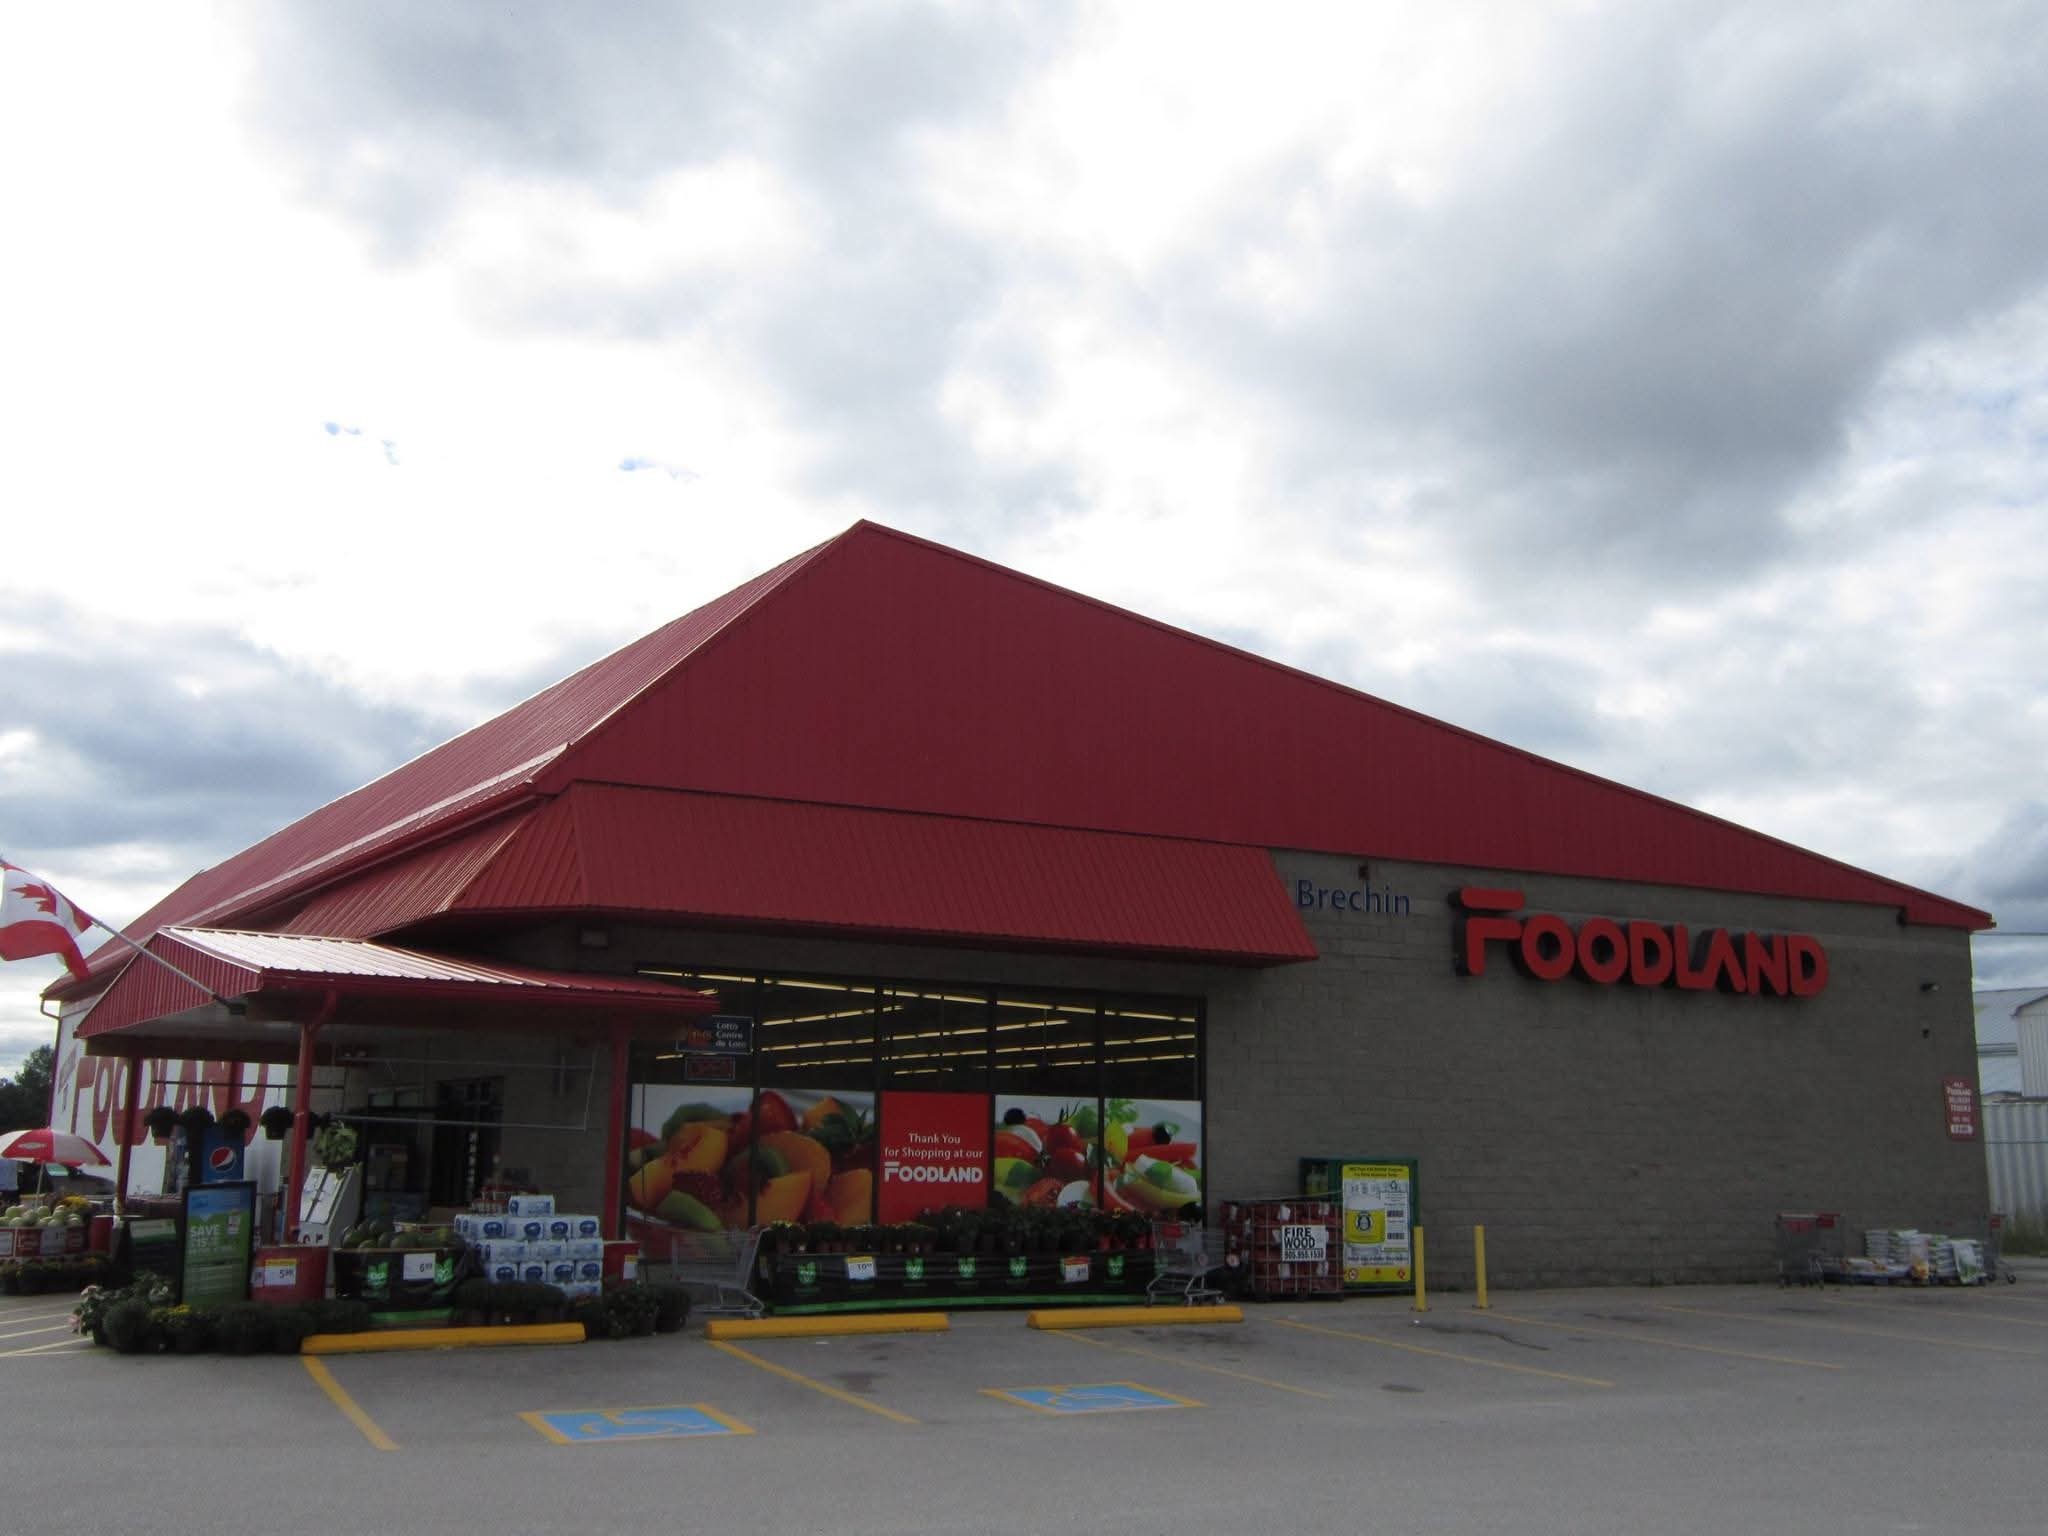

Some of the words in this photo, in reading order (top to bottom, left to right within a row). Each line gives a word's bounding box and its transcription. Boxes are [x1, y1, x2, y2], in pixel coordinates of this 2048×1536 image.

[1297, 879, 1410, 918] Brechin
[1459, 887, 1829, 998] FOODLAND
[908, 1132, 940, 1144] Thank
[941, 1133, 961, 1145] You
[884, 1146, 899, 1158] for
[901, 1146, 951, 1160] Shopping
[953, 1148, 963, 1158] at
[965, 1150, 984, 1159] our
[883, 1160, 984, 1183] FOODLAND
[1284, 1226, 1312, 1238] FIRE
[1283, 1237, 1316, 1250] WOOD
